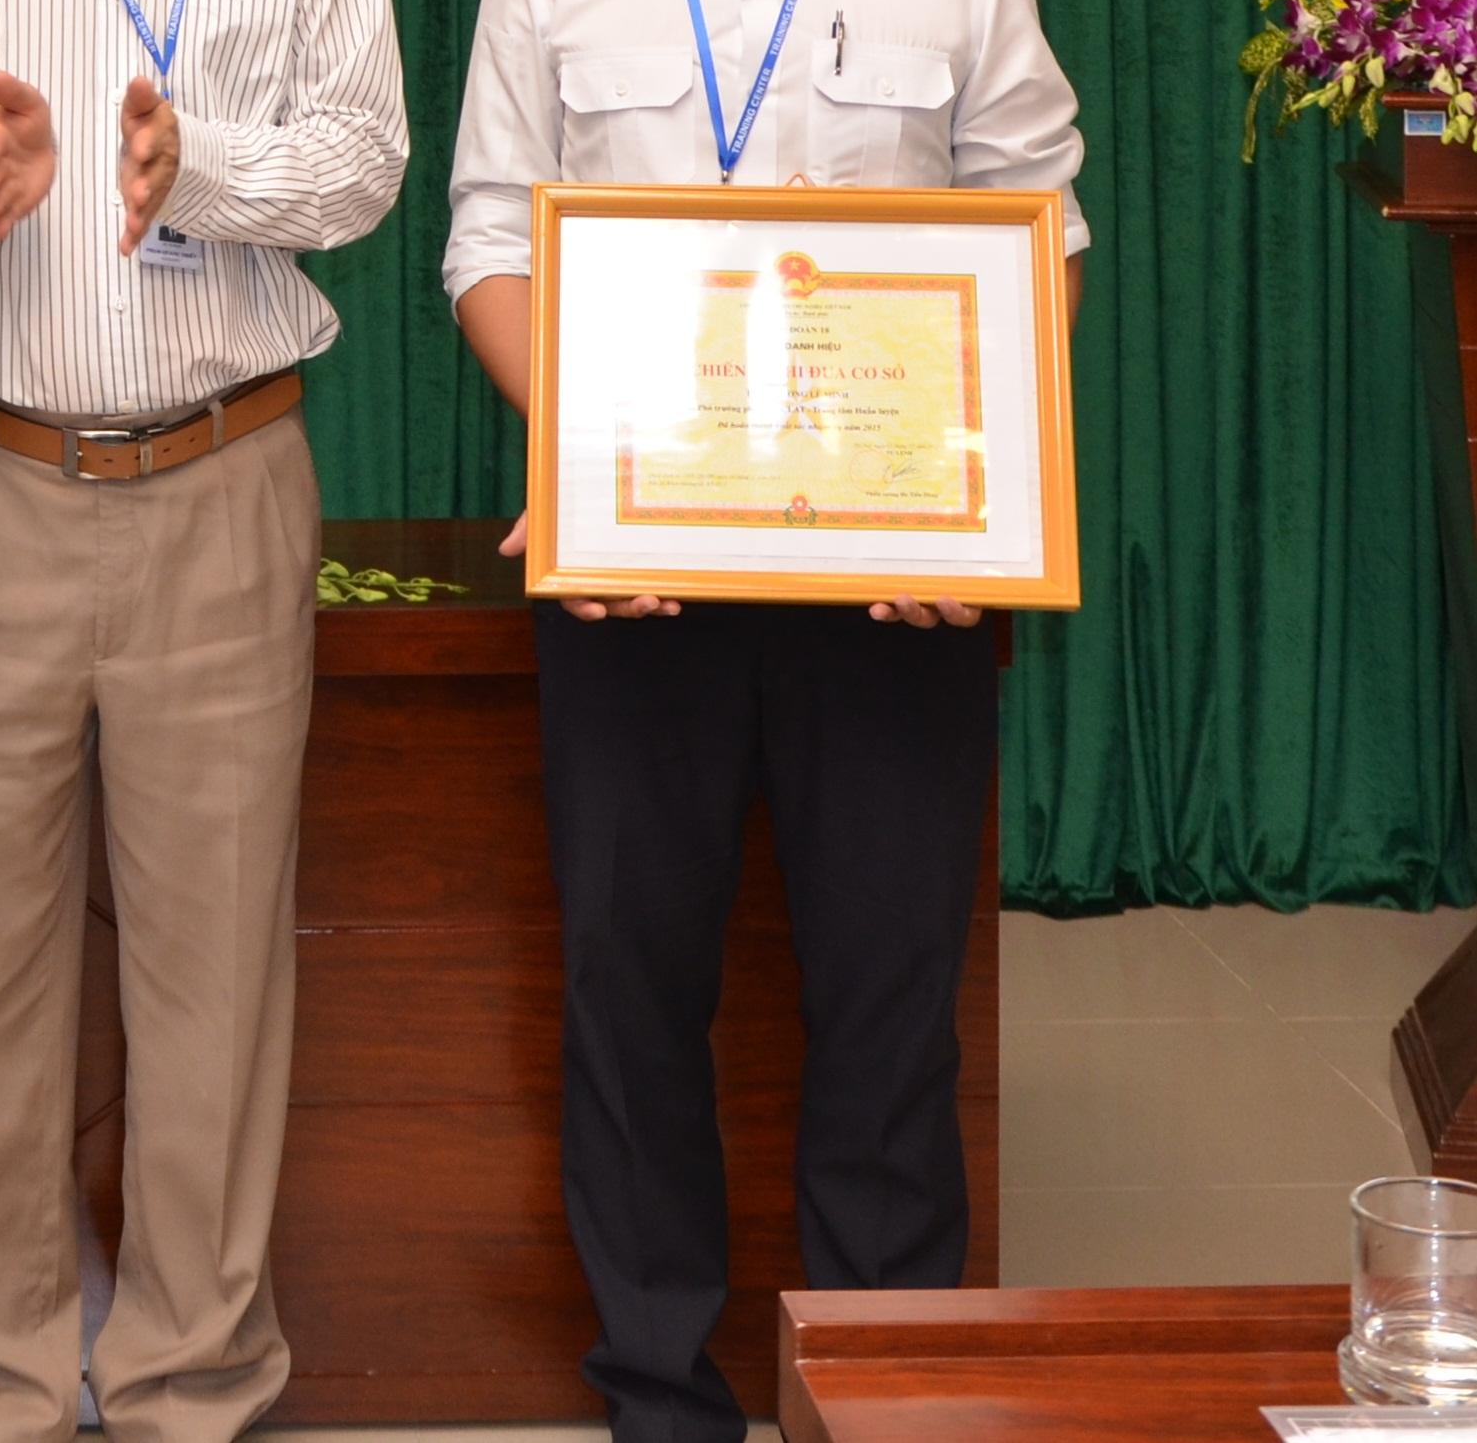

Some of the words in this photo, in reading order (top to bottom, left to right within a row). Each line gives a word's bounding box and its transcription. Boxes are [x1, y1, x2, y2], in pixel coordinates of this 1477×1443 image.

[770, 11, 792, 56] TRAINING
[731, 108, 756, 154] TRAINING
[750, 67, 772, 107] CENTER
